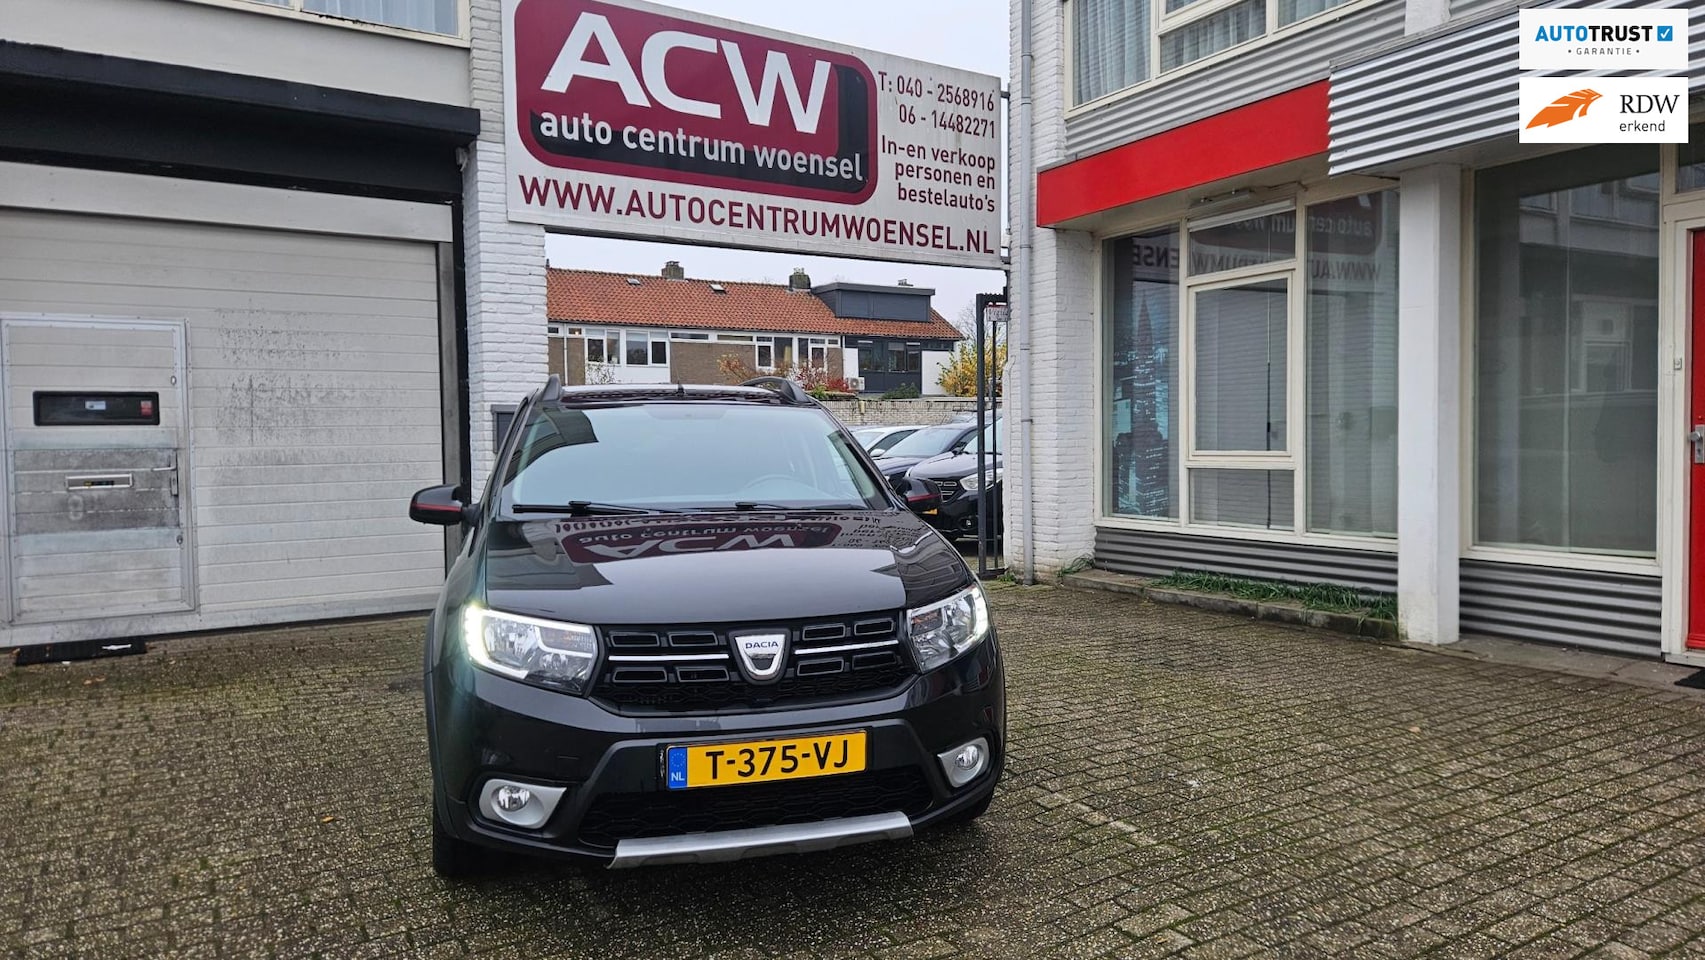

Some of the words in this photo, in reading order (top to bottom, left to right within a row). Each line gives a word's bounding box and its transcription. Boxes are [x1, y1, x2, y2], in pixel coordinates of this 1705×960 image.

[540, 11, 831, 134] ACW
[878, 71, 893, 93] T:
[897, 75, 922, 98] 040
[937, 83, 994, 112] 2568916
[899, 104, 916, 125] 06
[931, 109, 995, 138] 14482271
[540, 111, 612, 145] auto
[622, 125, 745, 165] centrum
[754, 144, 863, 182] woensel
[881, 135, 926, 161] In-en
[931, 145, 995, 171] verkoop
[895, 161, 972, 186] personen
[977, 174, 995, 190] en
[518, 174, 994, 254] WWW.AUTOCENTRUMWOENSEL.NL
[898, 182, 995, 212] bestelauto's
[745, 640, 779, 650] DACIA
[670, 771, 685, 782] NL
[705, 739, 848, 780] T-375-VJ
